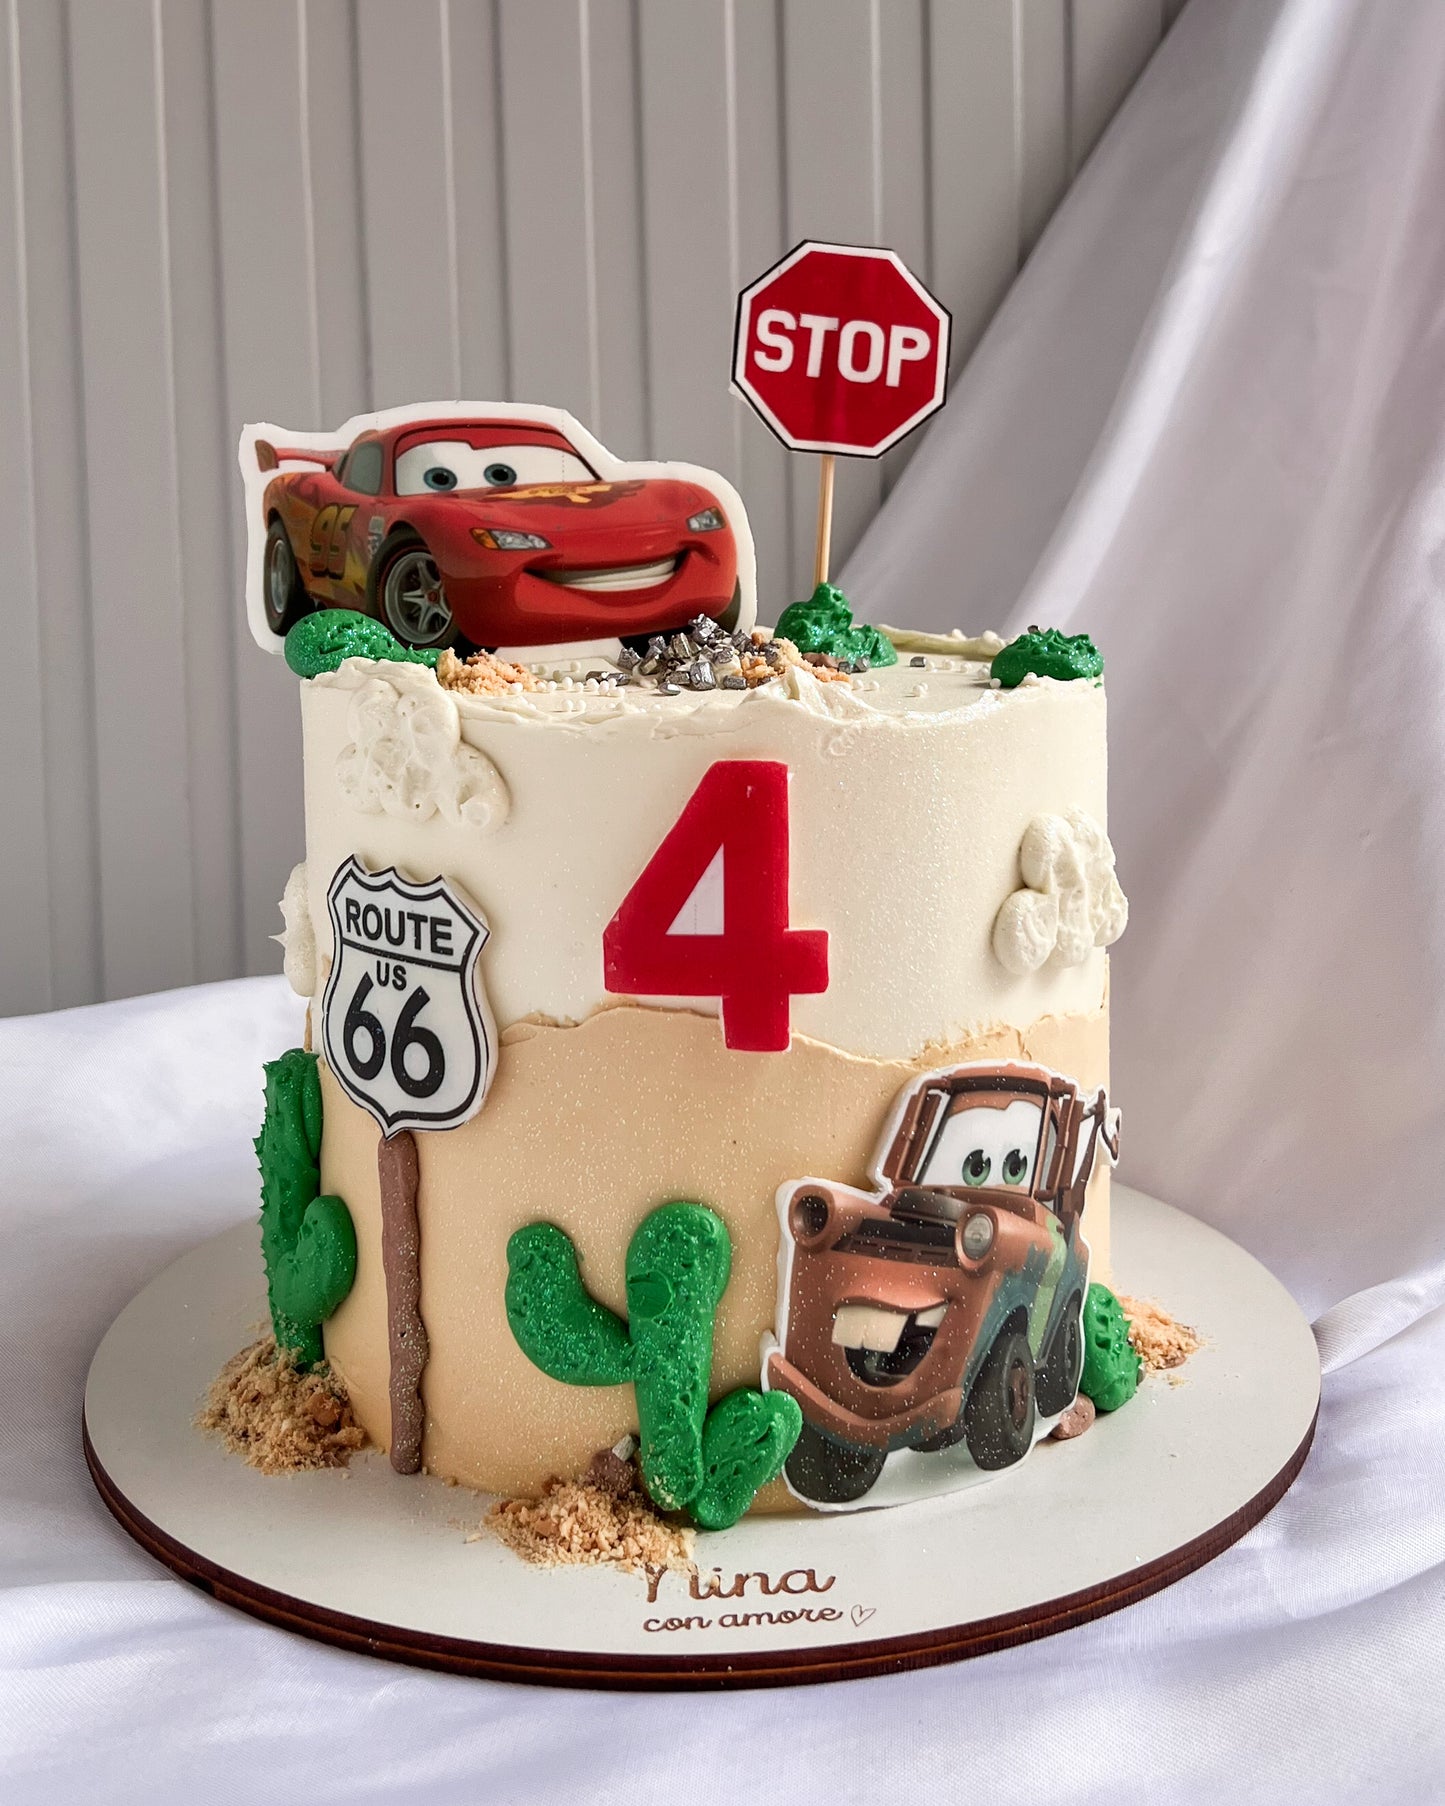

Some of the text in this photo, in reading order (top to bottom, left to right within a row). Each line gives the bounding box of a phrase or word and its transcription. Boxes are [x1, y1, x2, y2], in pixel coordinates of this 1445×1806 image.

[753, 308, 932, 388] STOP
[310, 503, 358, 580] 95
[345, 897, 454, 956] ROUTE
[602, 759, 829, 1053] 4
[376, 960, 407, 991] US
[343, 971, 446, 1099] 66
[643, 1606, 844, 1633] con amore
